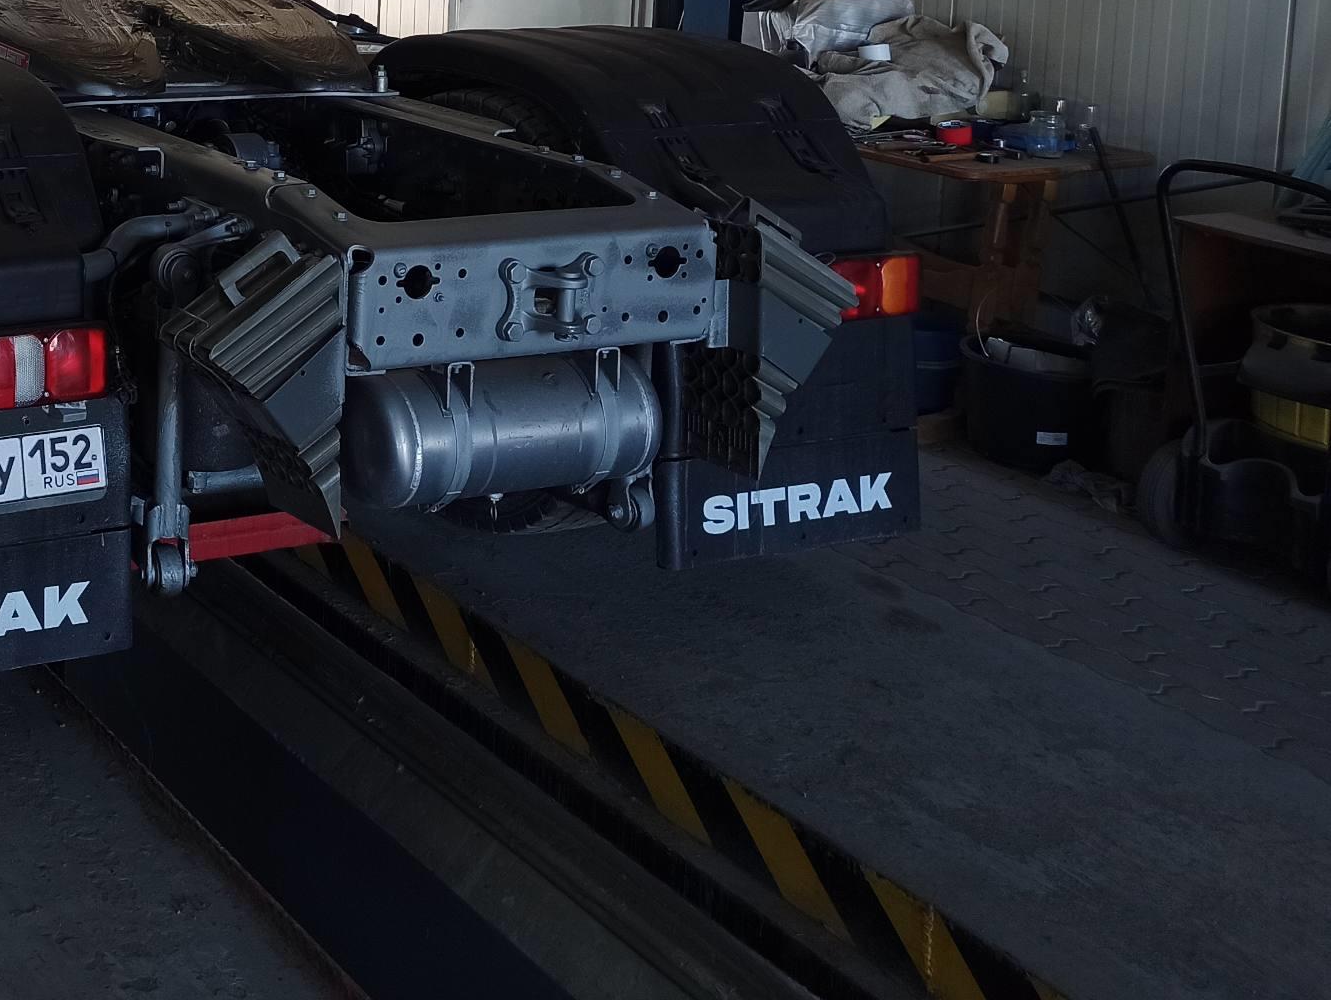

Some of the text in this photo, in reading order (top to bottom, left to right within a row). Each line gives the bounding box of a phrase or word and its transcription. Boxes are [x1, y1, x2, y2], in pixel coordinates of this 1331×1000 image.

[28, 434, 93, 475] 152
[44, 473, 75, 489] RUS
[703, 472, 892, 534] SITRAK
